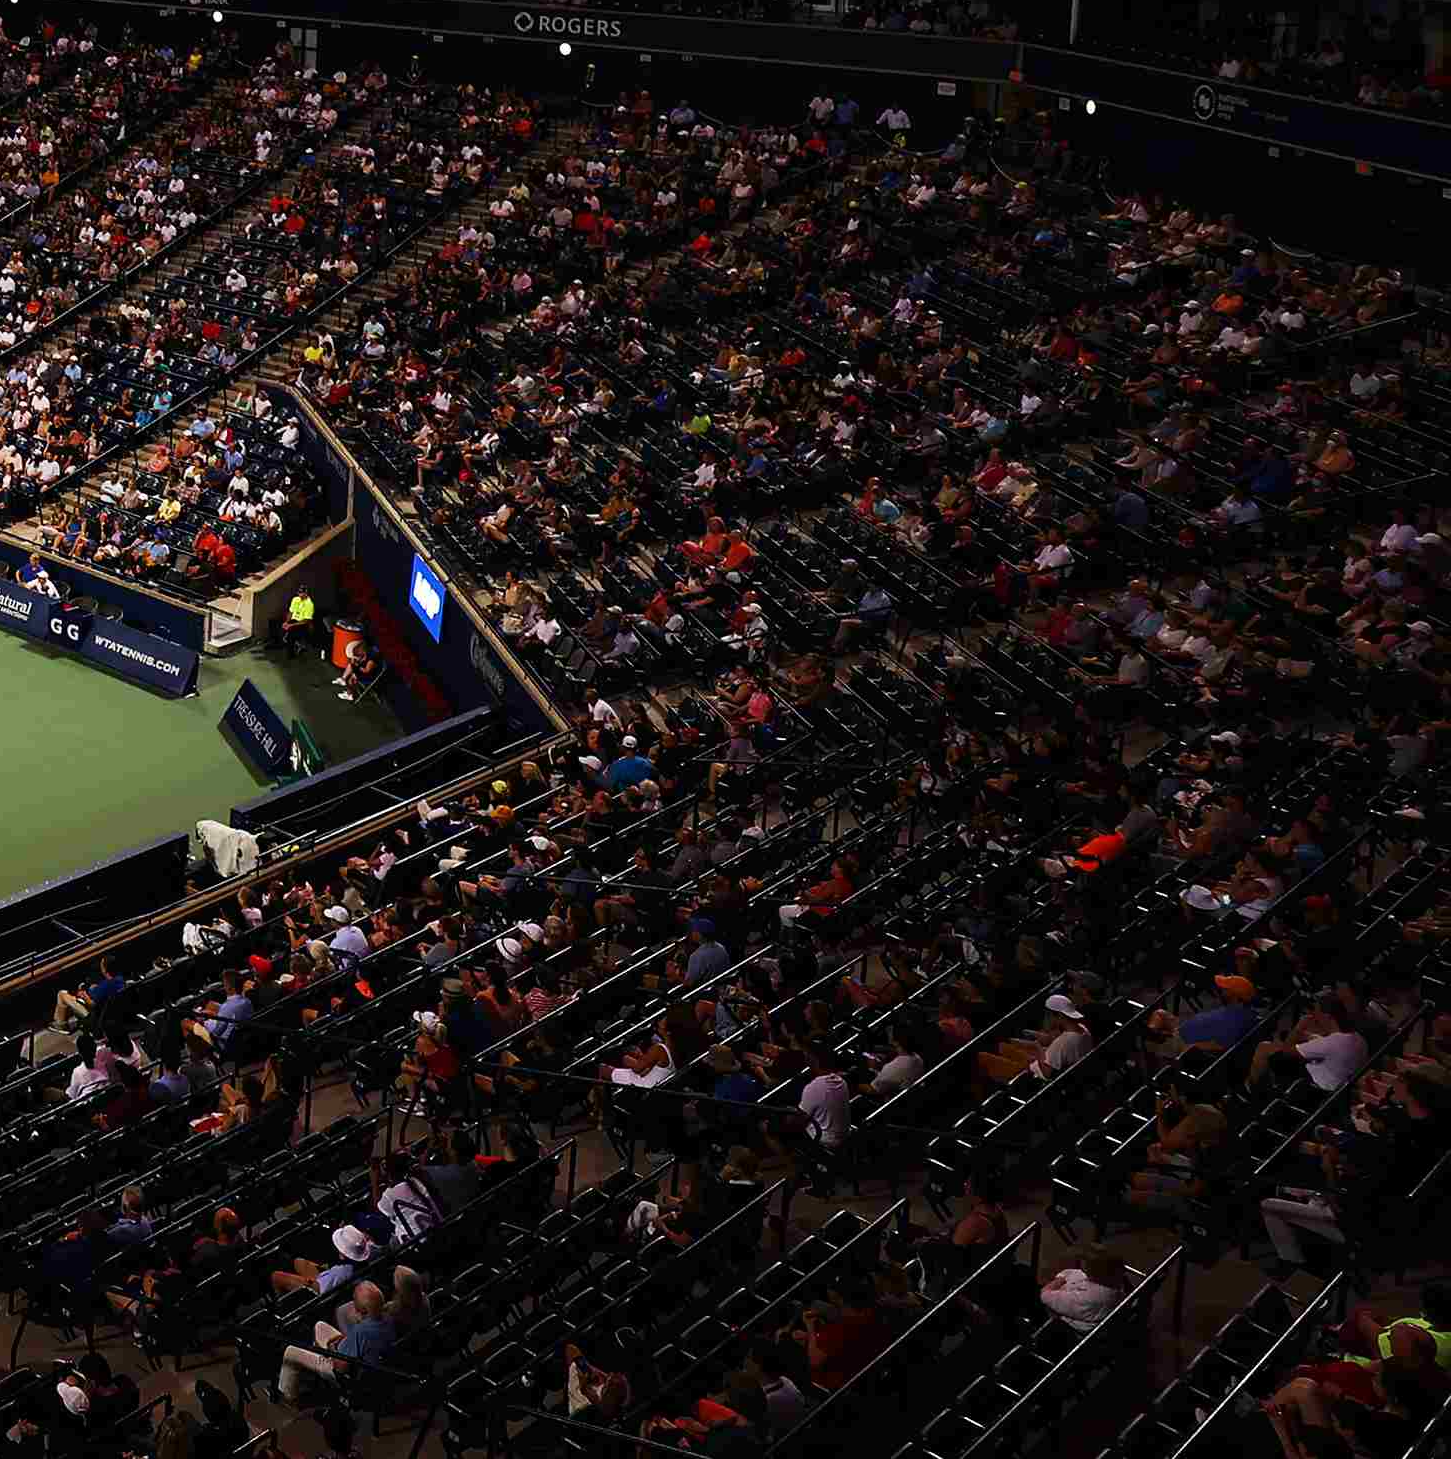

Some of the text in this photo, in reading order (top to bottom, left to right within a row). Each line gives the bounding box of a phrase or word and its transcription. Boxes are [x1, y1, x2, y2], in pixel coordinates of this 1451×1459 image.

[539, 15, 622, 37] ROGERS
[50, 617, 80, 641] G G
[94, 635, 181, 677] WTATENNIS.COM
[235, 695, 267, 741] TREASURE
